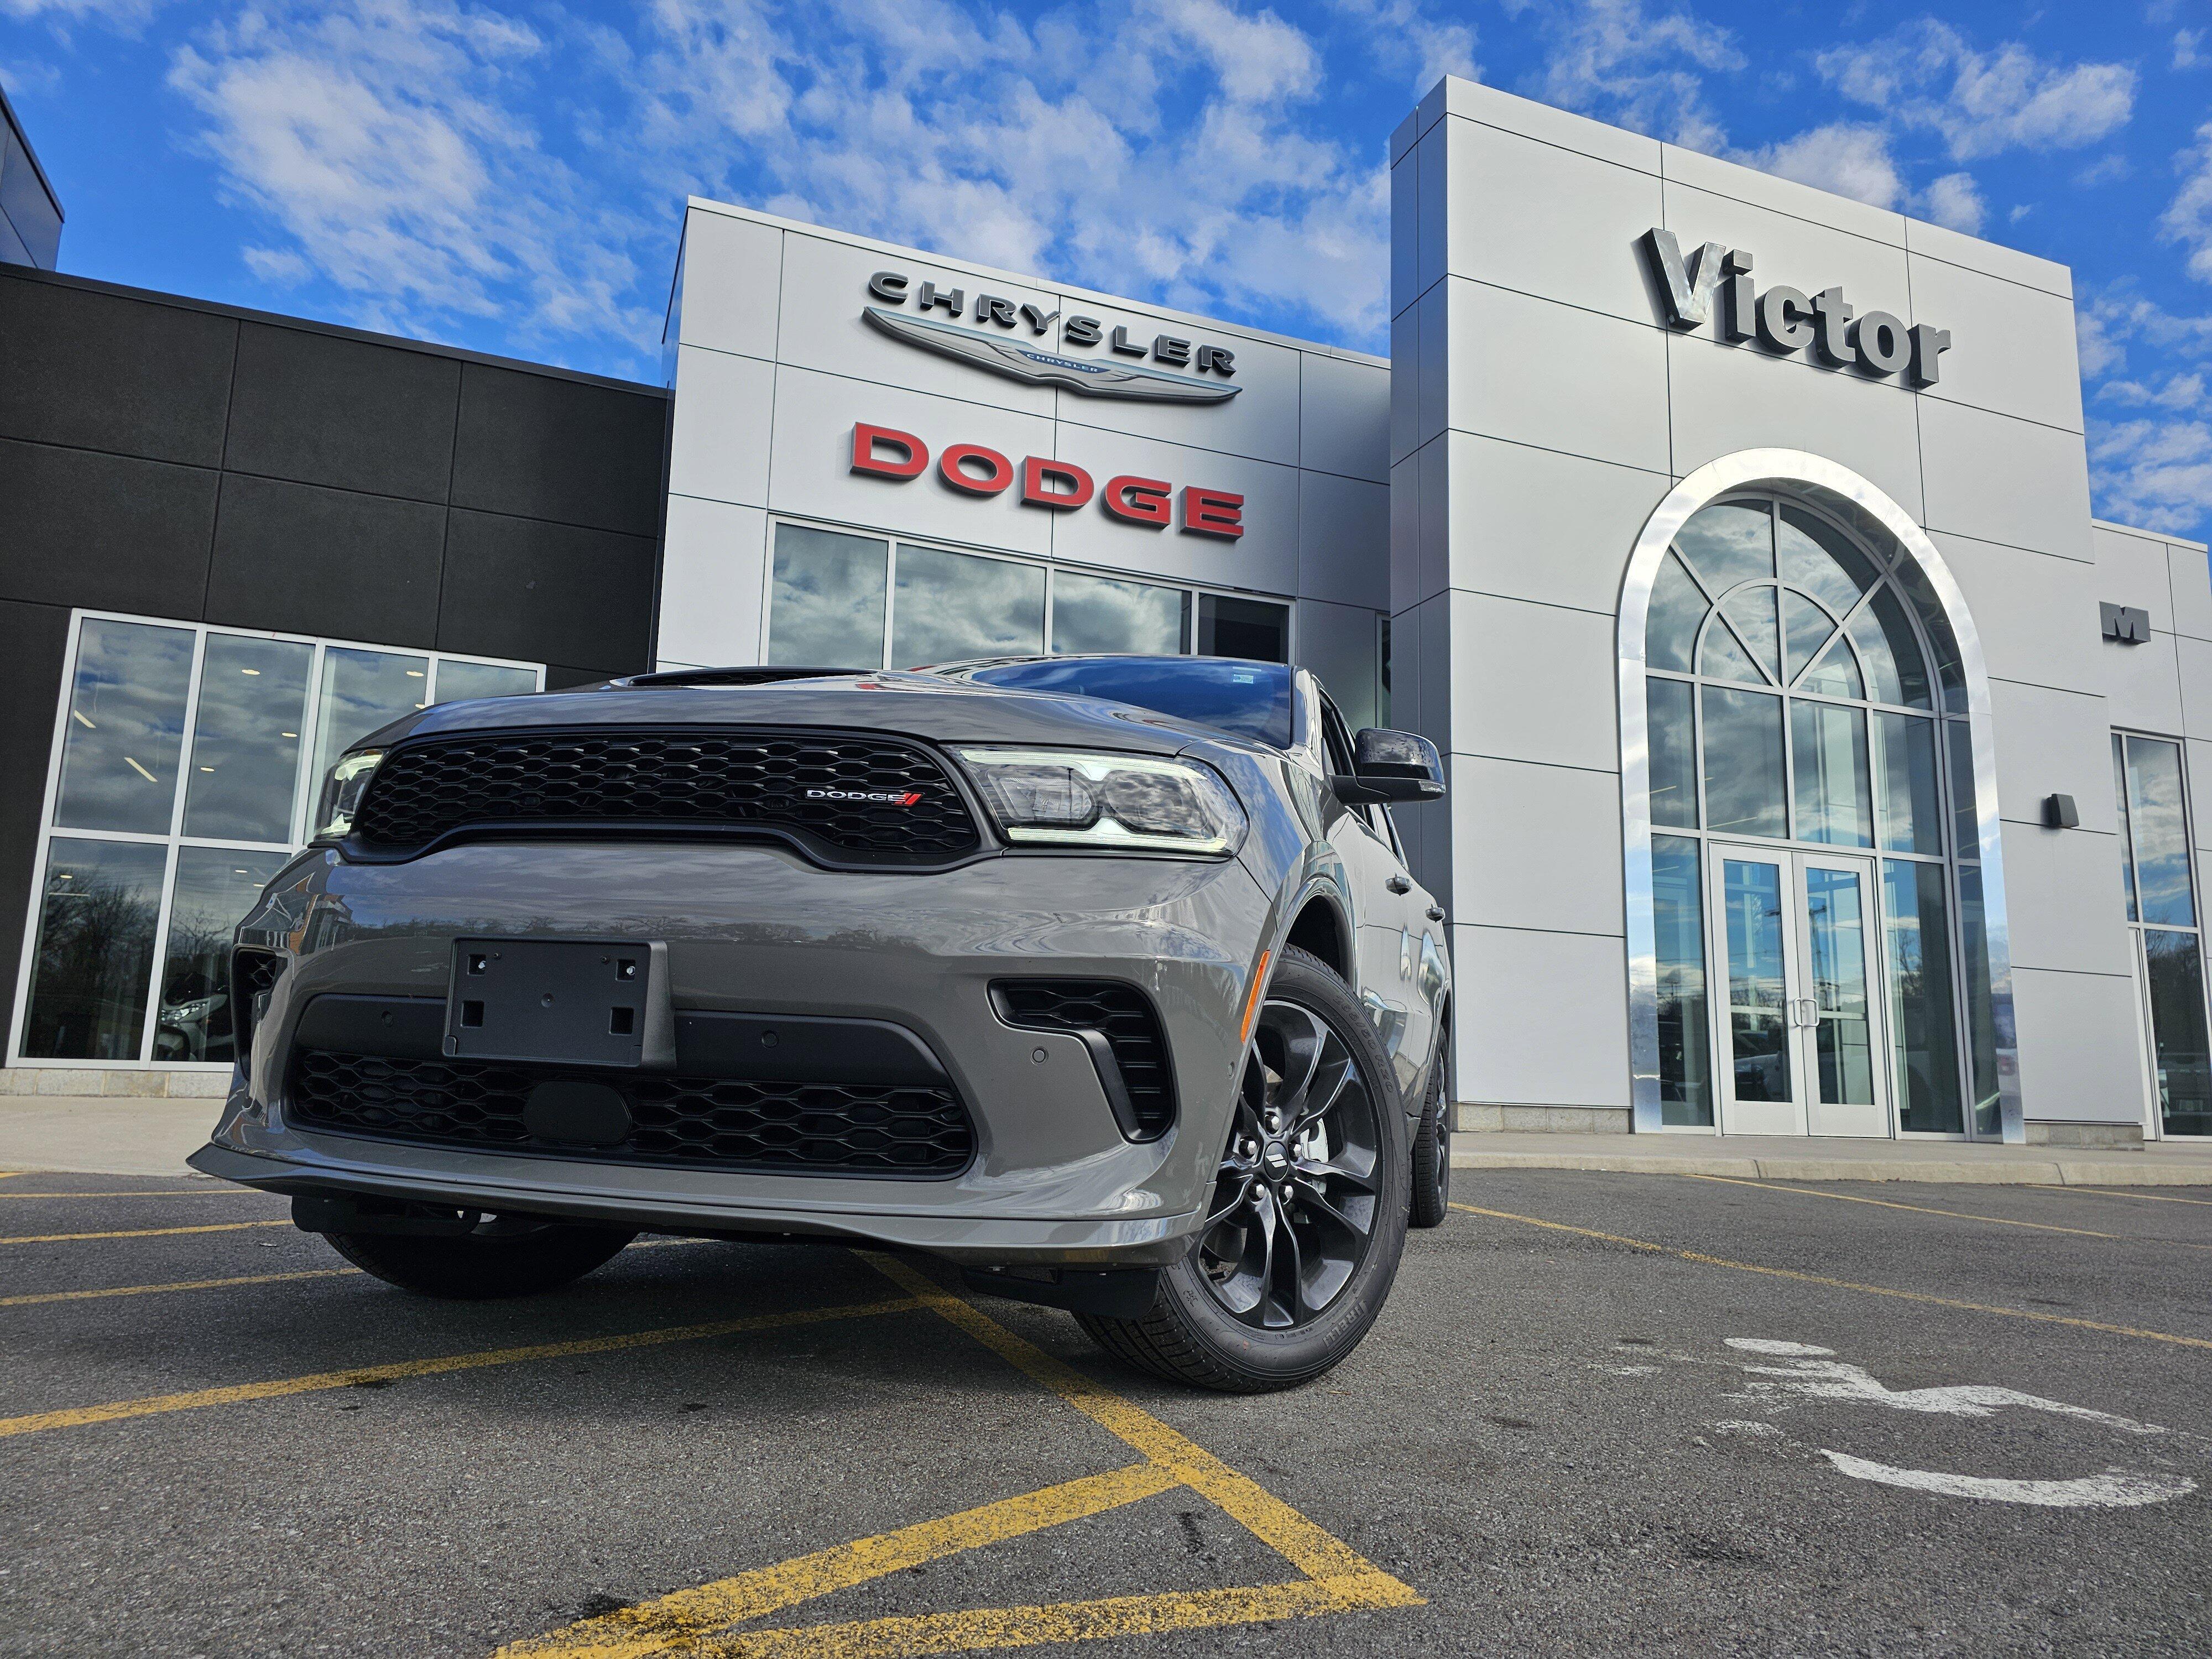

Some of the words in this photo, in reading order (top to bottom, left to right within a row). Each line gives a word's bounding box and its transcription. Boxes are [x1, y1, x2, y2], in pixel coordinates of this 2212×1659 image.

[869, 272, 1237, 375] CHRYSLER
[1641, 227, 1950, 389] Victor
[1026, 353, 1098, 372] CHRYSLER
[850, 421, 1244, 542] DODGE
[807, 790, 906, 802] DODGE
[1322, 1300, 1369, 1350] PIRELLI
